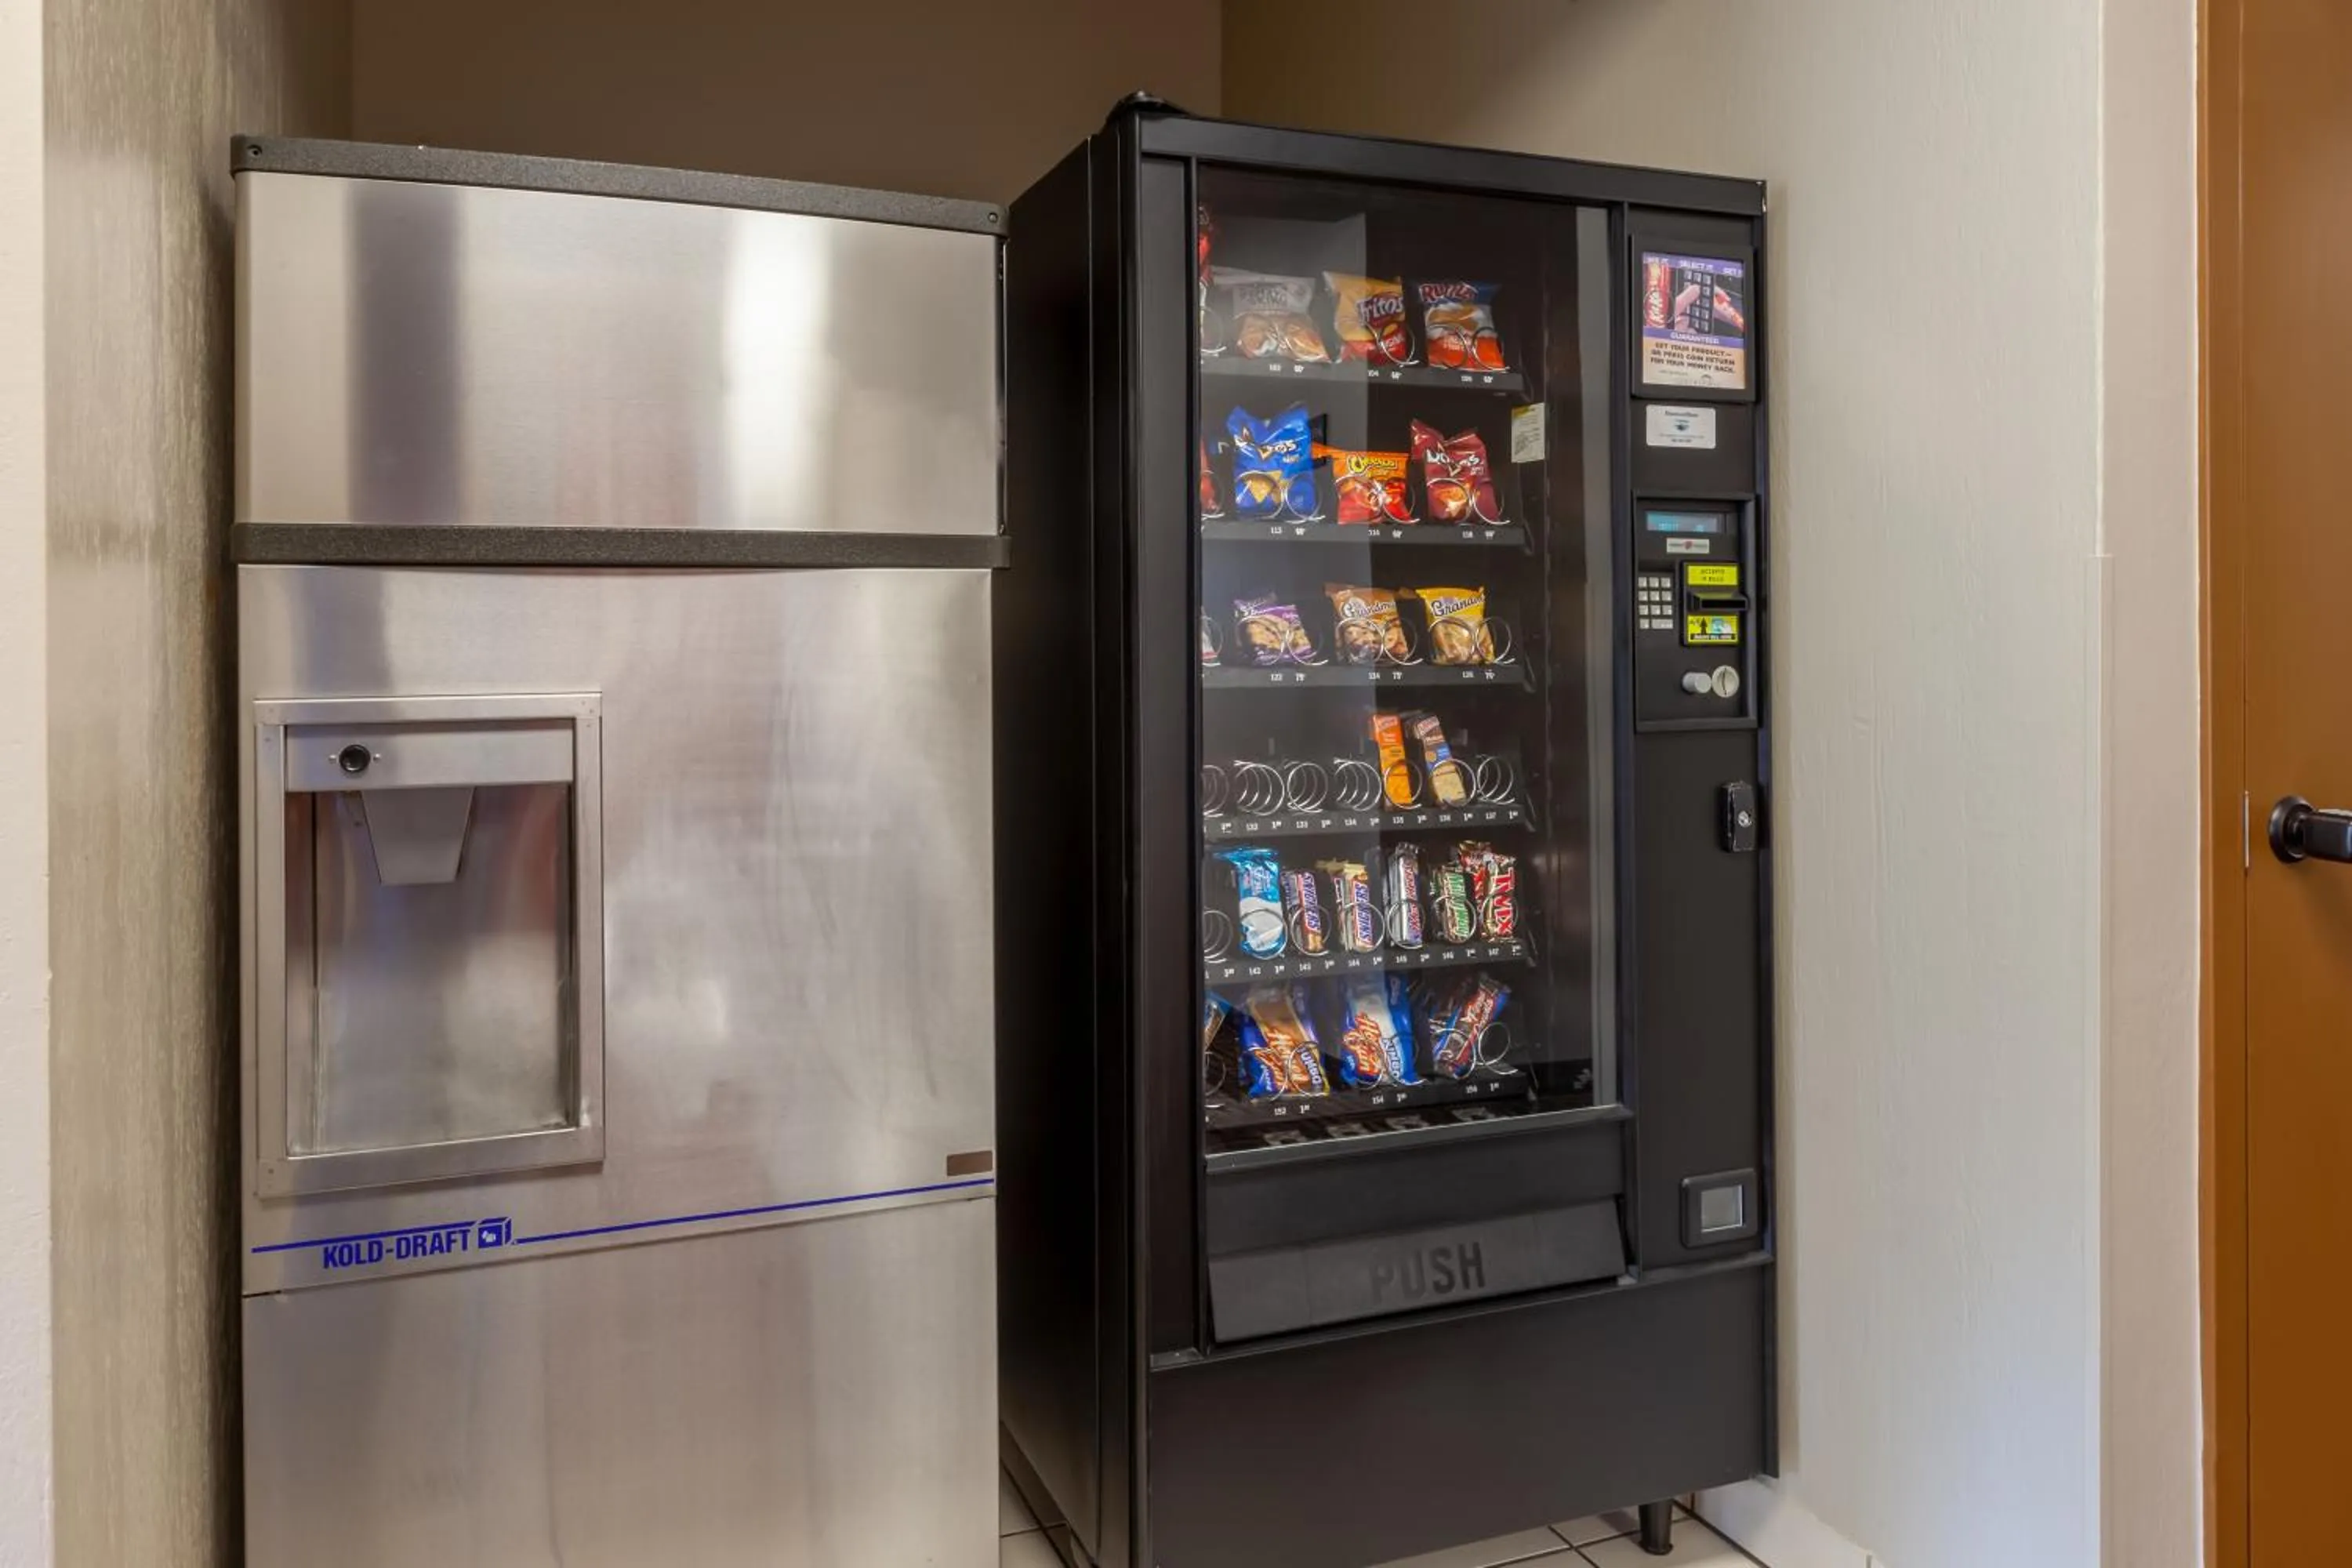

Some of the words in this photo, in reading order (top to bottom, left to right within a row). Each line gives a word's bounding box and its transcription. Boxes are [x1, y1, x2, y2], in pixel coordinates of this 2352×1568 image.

[1356, 297, 1404, 327] Fritos
[1692, 347, 1725, 357] PRODUCT
[1492, 866, 1515, 936] TWIX
[322, 1229, 471, 1269] KOLD-DRAFT
[1370, 1241, 1486, 1305] PUSH
